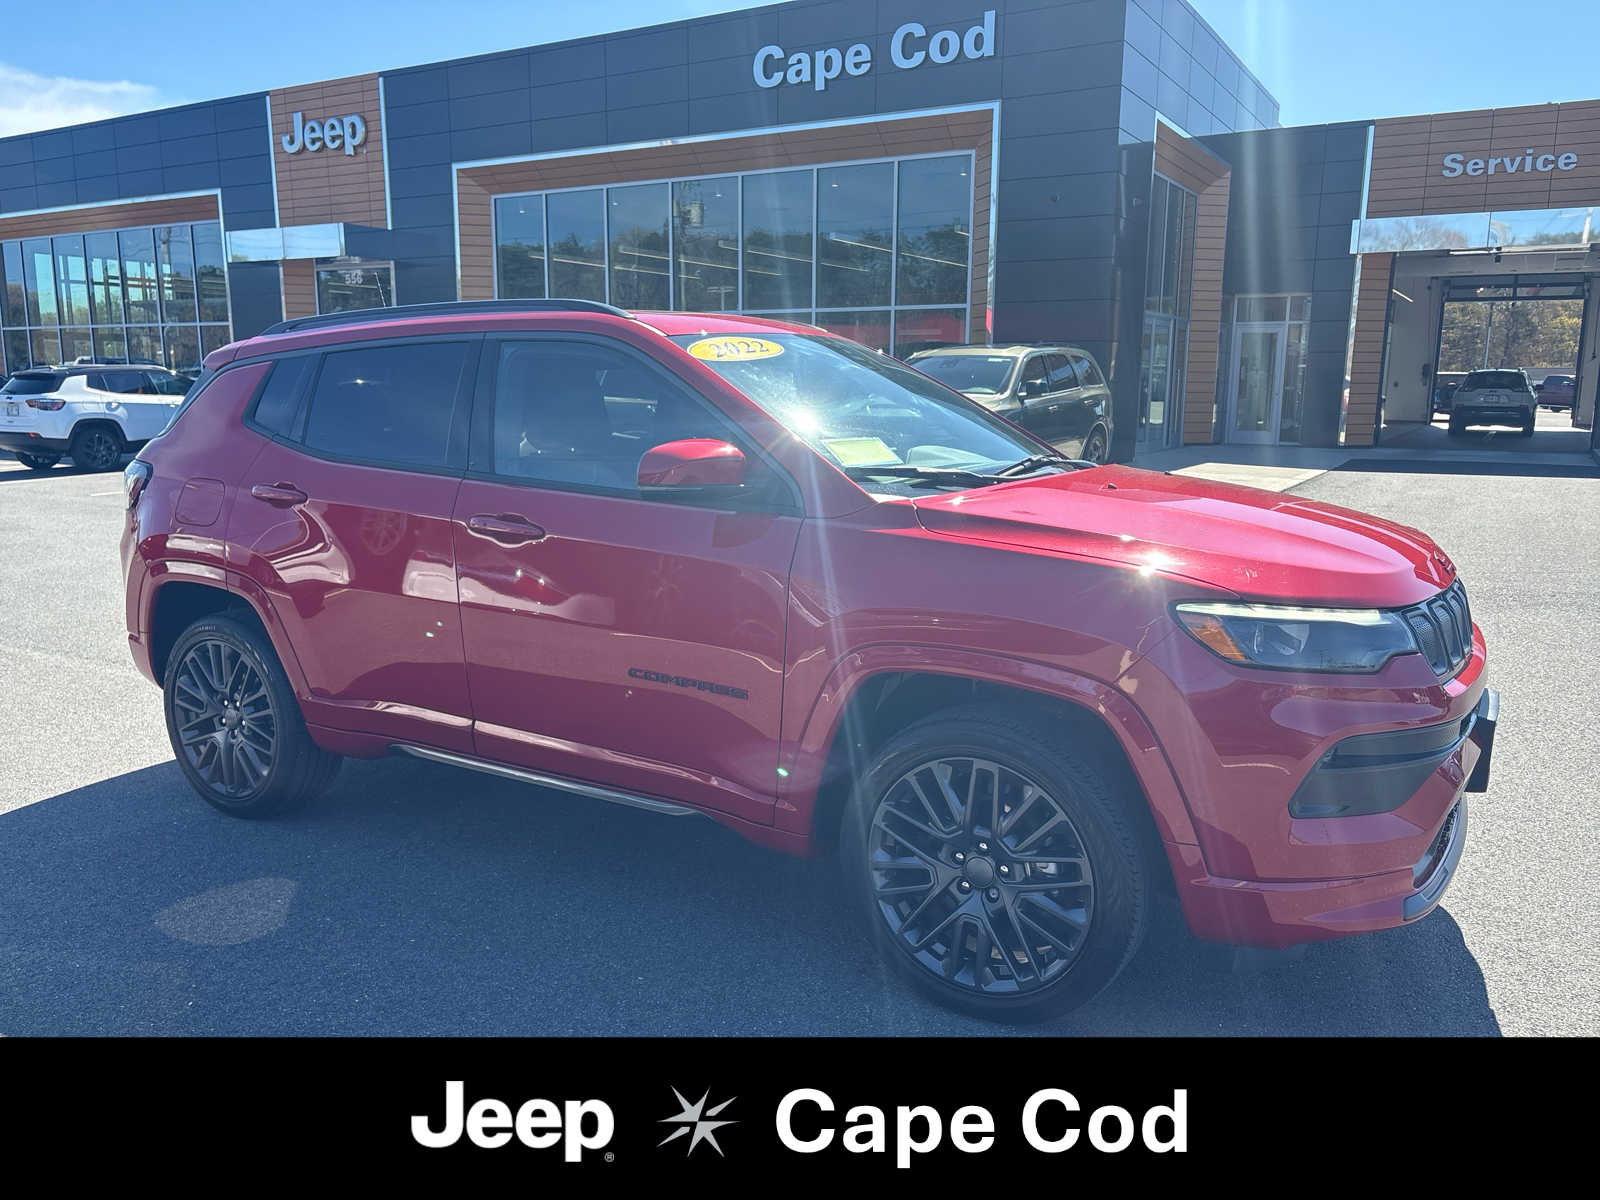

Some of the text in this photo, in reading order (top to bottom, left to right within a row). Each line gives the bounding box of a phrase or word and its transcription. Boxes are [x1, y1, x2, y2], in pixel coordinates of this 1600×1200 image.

[753, 10, 996, 91] Cape Cod
[282, 112, 367, 156] Jeep
[1442, 148, 1578, 178] Service
[709, 341, 769, 358] 2022
[628, 667, 749, 700] COMPASS
